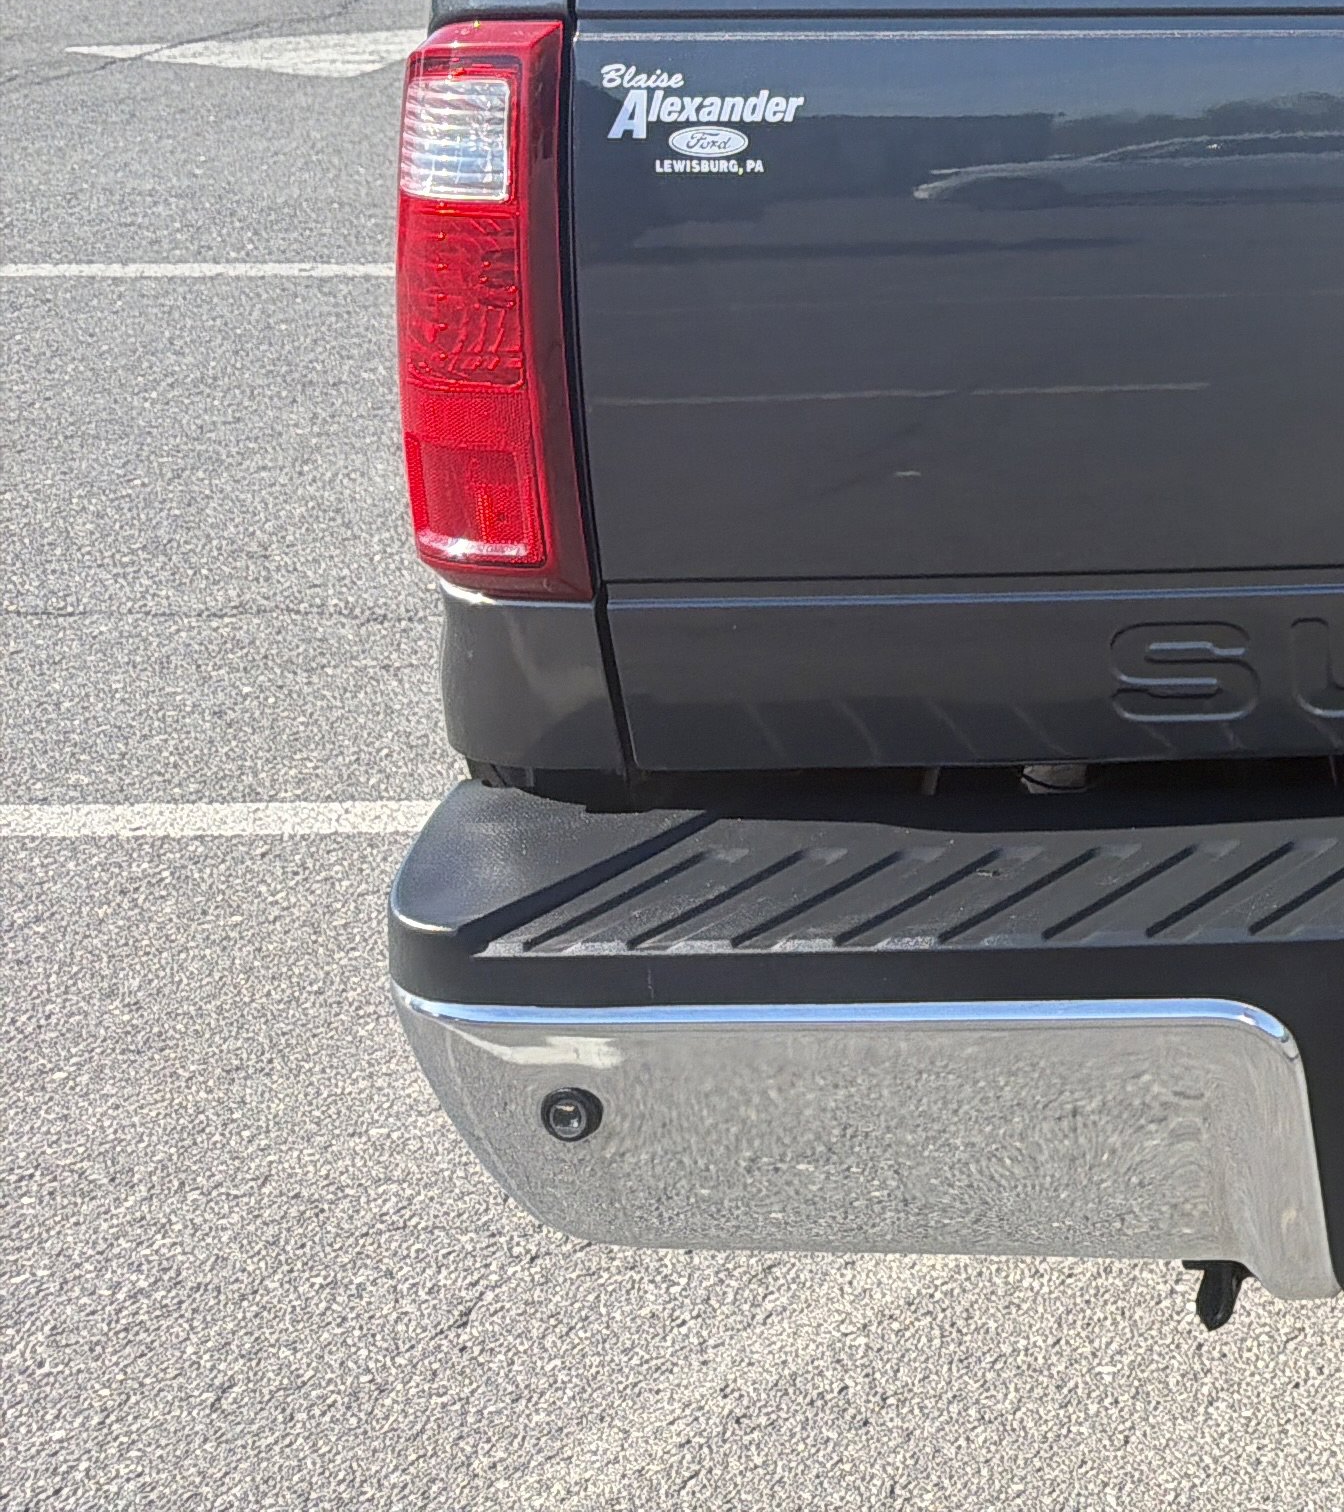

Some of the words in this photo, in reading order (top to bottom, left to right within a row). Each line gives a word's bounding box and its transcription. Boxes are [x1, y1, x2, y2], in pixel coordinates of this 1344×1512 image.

[601, 63, 684, 88] Blaise
[607, 89, 804, 139] Alexander
[686, 131, 730, 150] Ford
[655, 159, 744, 175] LEWISBURG,
[746, 159, 764, 173] PA
